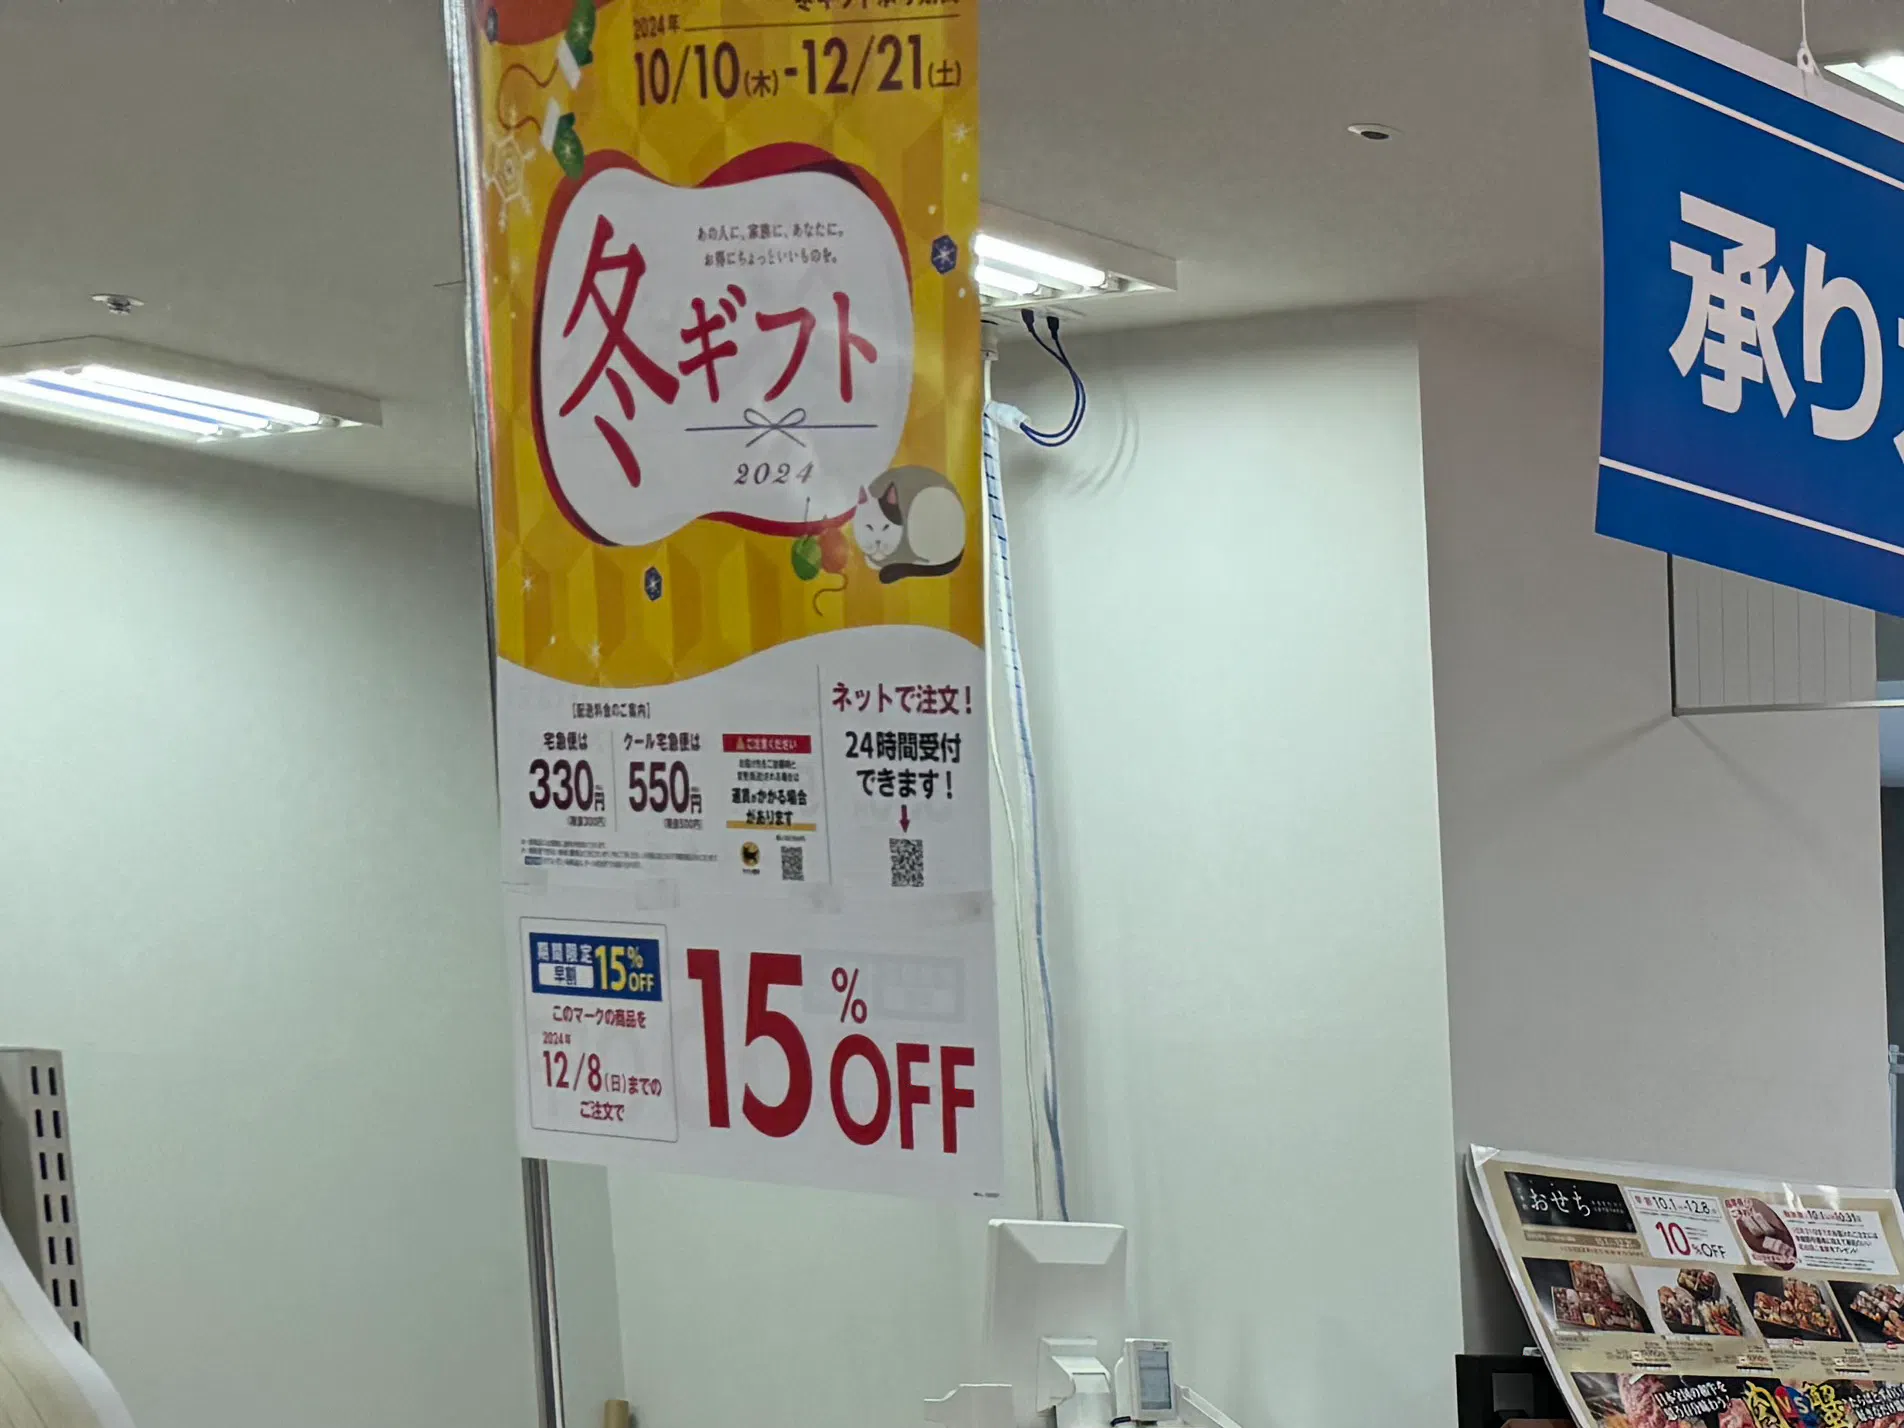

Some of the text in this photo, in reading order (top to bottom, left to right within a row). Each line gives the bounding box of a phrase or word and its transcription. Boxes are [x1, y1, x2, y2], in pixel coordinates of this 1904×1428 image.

[558, 212, 878, 490] 冬ギフト
[732, 460, 817, 488] 2024
[831, 680, 973, 718] ネットで注文！
[543, 731, 589, 752] 宅急便は
[623, 731, 702, 753] クール宅急便は
[844, 730, 962, 764] 24時間受付
[854, 766, 955, 802] できます！
[744, 810, 794, 827] があります
[553, 965, 578, 987] 早割
[628, 972, 655, 993] OFF
[551, 1004, 648, 1030] このマークの商品を
[828, 1031, 977, 1156] OFF
[579, 1099, 626, 1123] ご注文で
[1529, 1186, 1592, 1218] おせち
[1700, 1242, 1727, 1260] OFF
